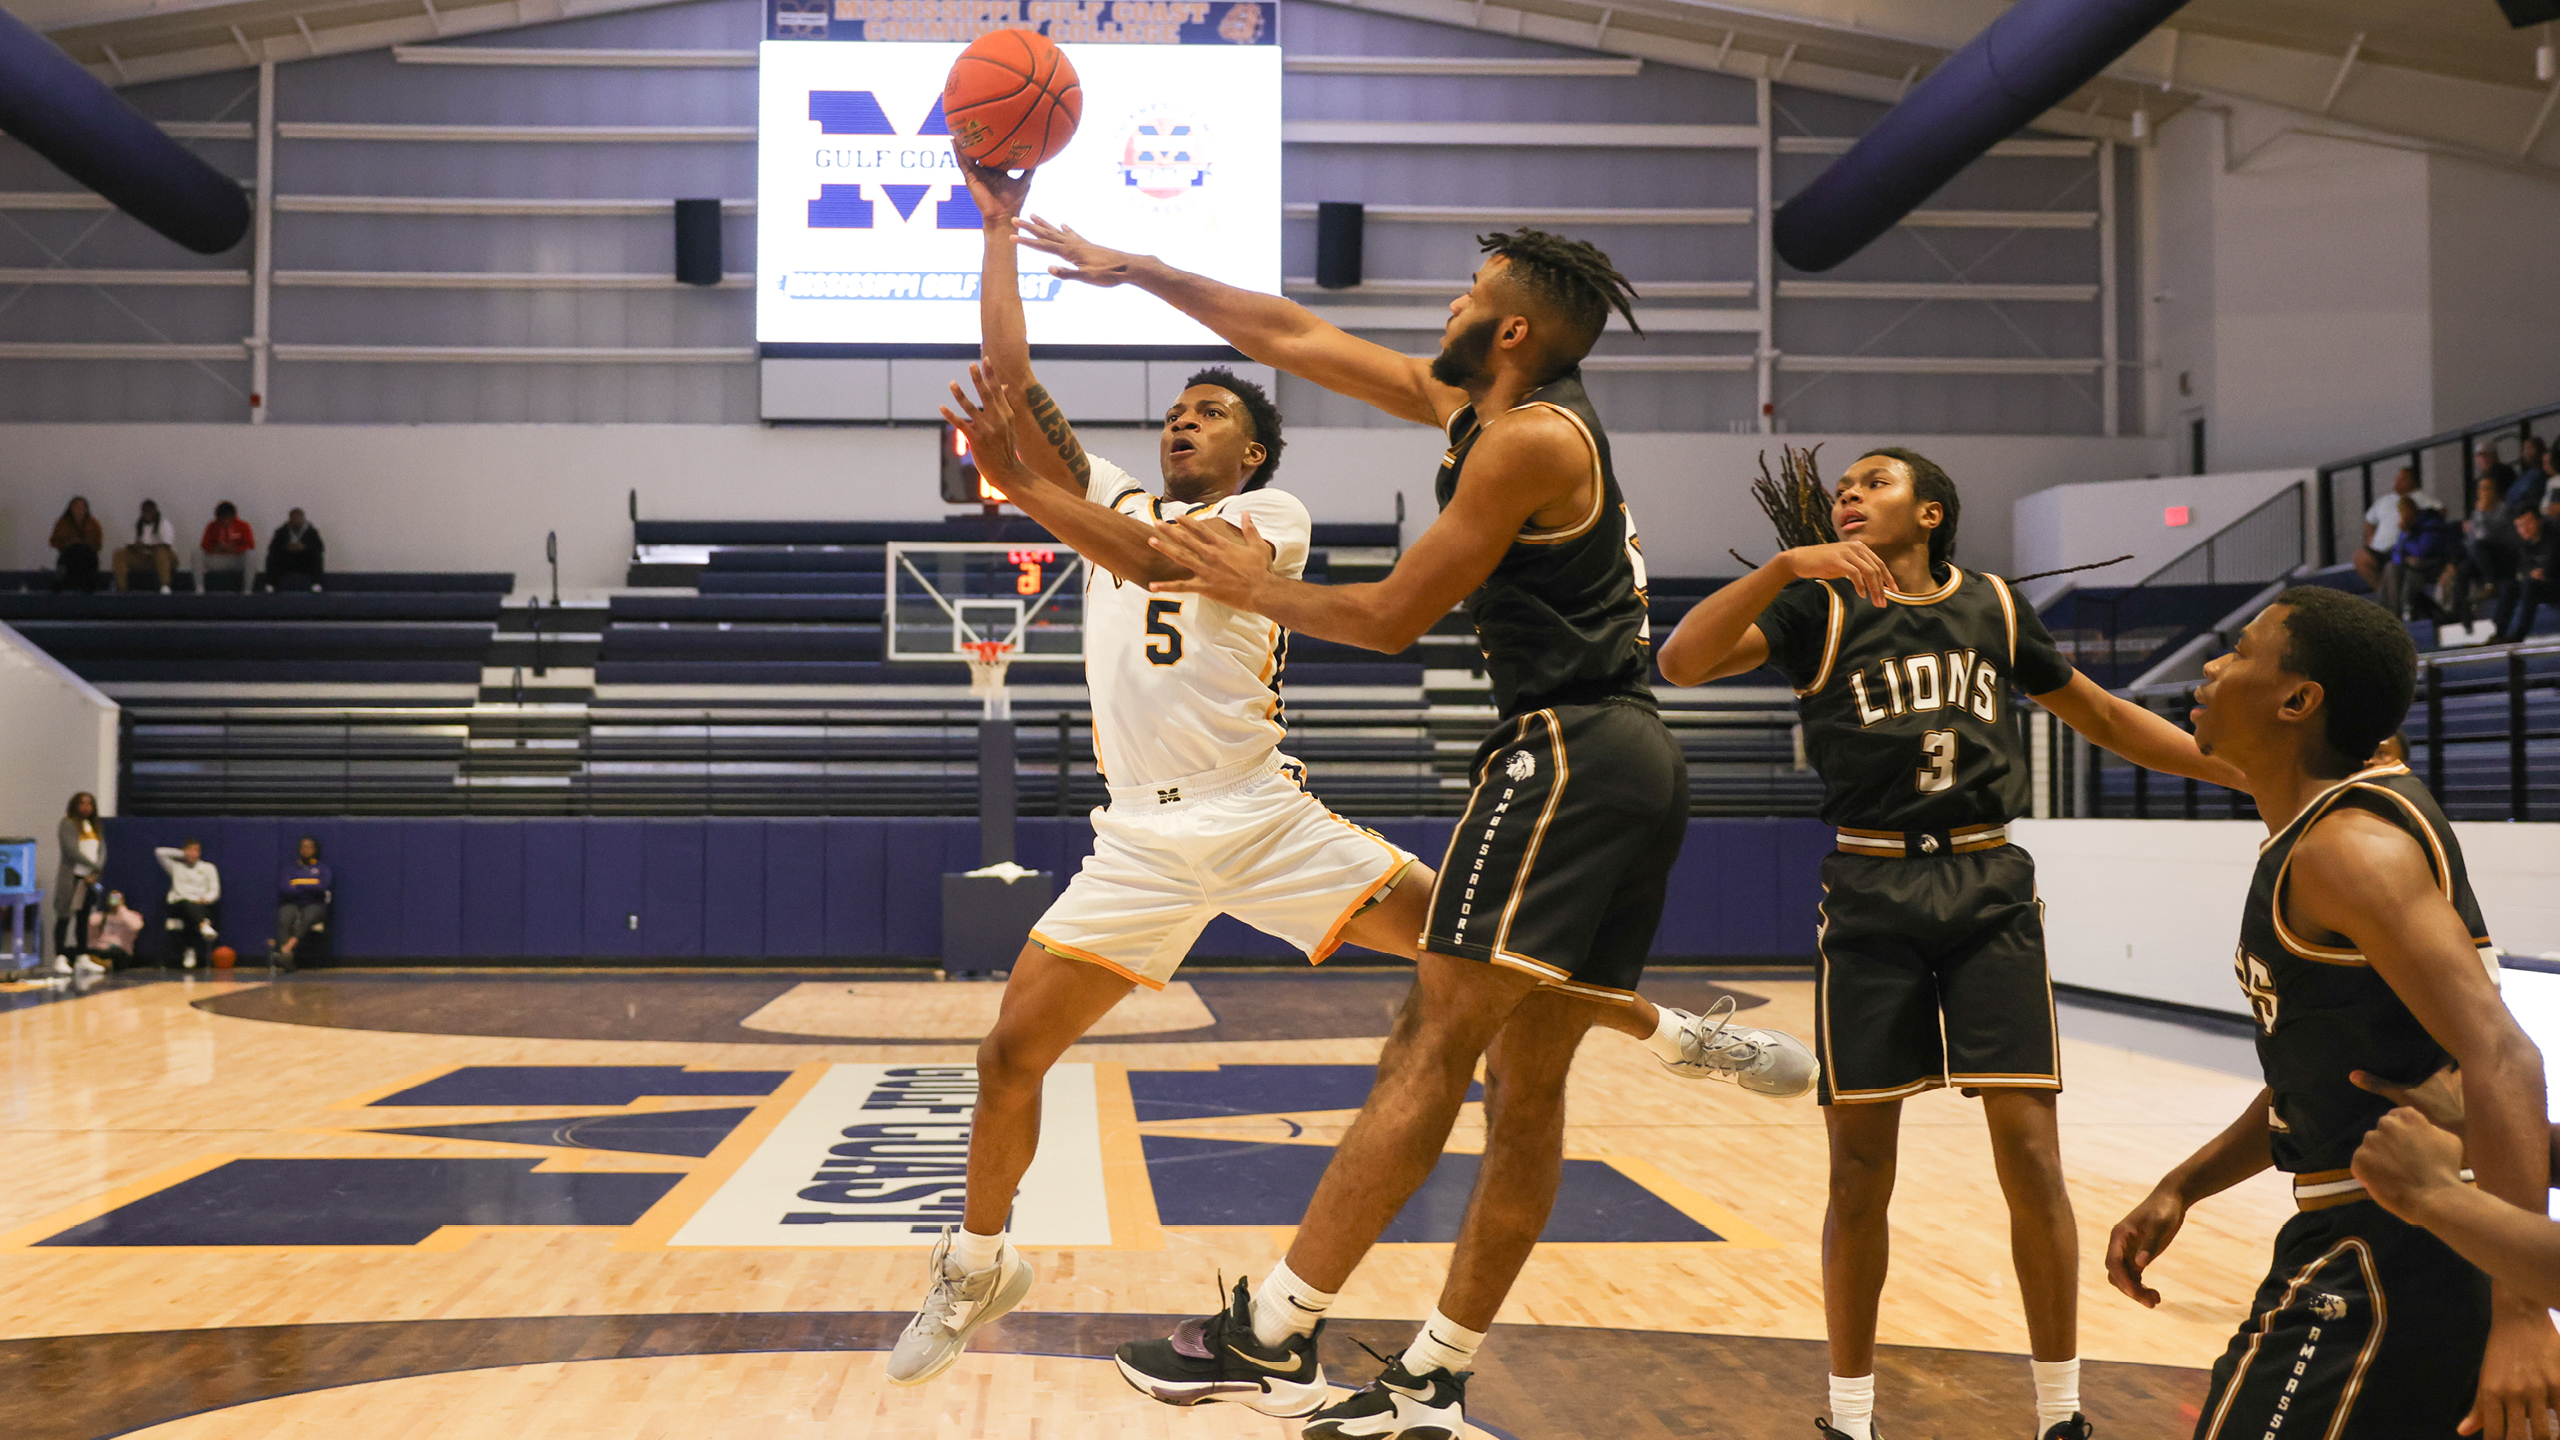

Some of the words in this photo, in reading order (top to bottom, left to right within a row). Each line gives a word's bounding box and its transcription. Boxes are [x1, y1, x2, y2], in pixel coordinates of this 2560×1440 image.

[835, 1, 1020, 19] MISSISSIPPI
[1028, 1, 1103, 21] GULF
[1112, 2, 1209, 23] COAST
[1049, 23, 1180, 42] COLLEGE
[816, 150, 890, 168] GULF
[901, 150, 957, 168] COA
[788, 272, 921, 298] MISSISSIPPI
[921, 273, 979, 298] GULF
[1145, 598, 1184, 666] 5
[1848, 648, 1997, 728] LIONS
[1916, 728, 1958, 795] 3
[1454, 788, 1514, 945] AMBASSADORS
[779, 1122, 1020, 1233] COAST
